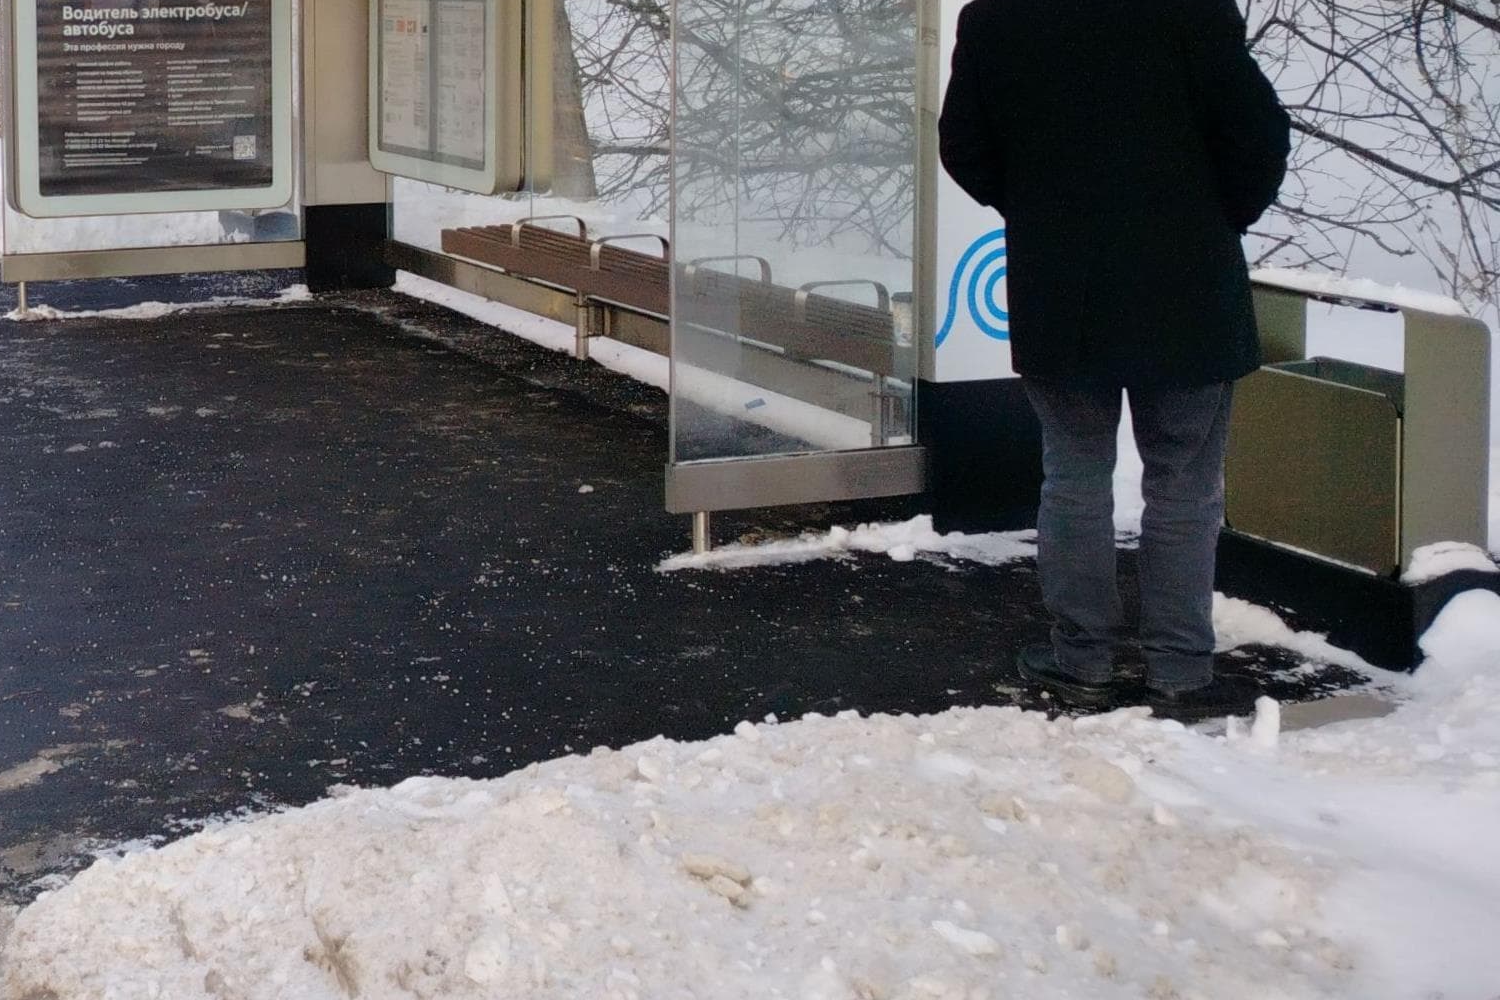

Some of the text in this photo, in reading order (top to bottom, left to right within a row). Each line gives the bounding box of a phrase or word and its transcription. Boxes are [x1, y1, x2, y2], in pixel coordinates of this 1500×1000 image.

[62, 2, 248, 21] Водитель электробуса/
[63, 21, 134, 38] автобуса
[63, 41, 185, 53] Эта профессия нужна городу
